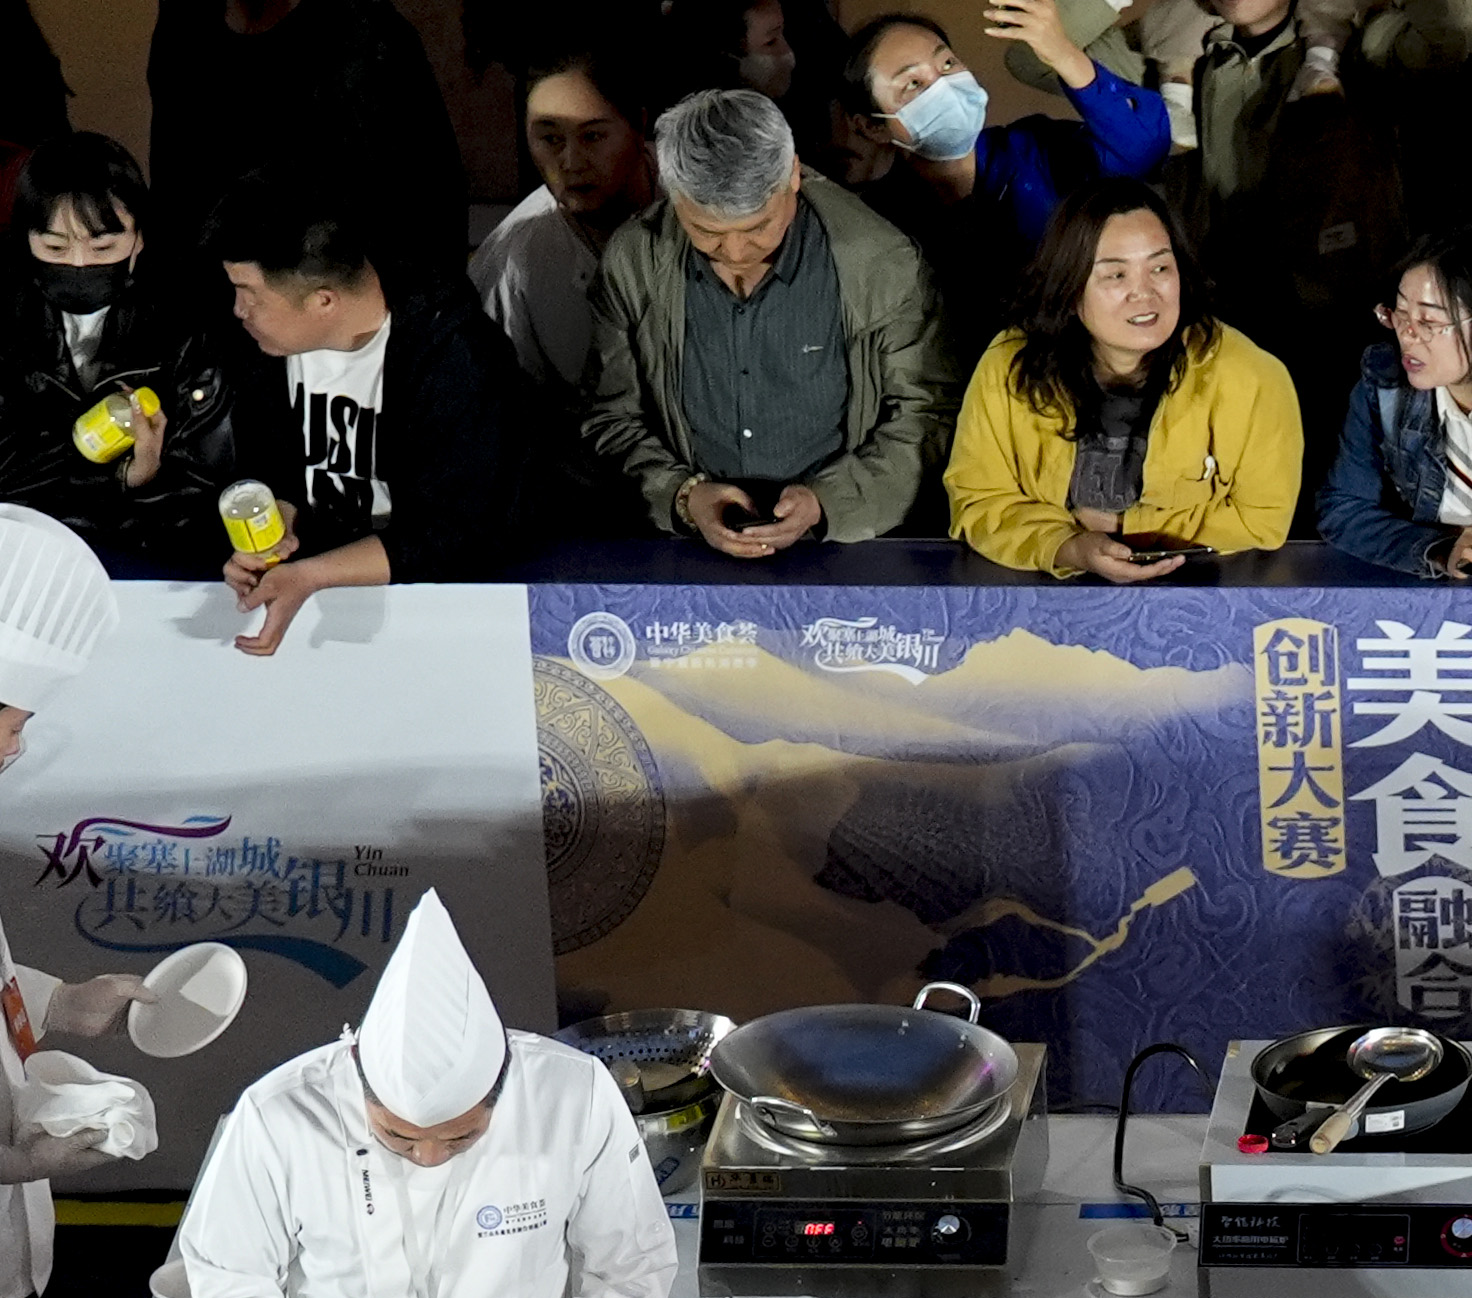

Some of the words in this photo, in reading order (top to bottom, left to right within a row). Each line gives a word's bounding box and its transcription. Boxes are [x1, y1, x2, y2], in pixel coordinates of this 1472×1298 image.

[646, 621, 758, 645] 中华美食荟
[1259, 627, 1345, 870] 创新大赛
[355, 845, 385, 862] Yin
[355, 863, 411, 878] Chuan
